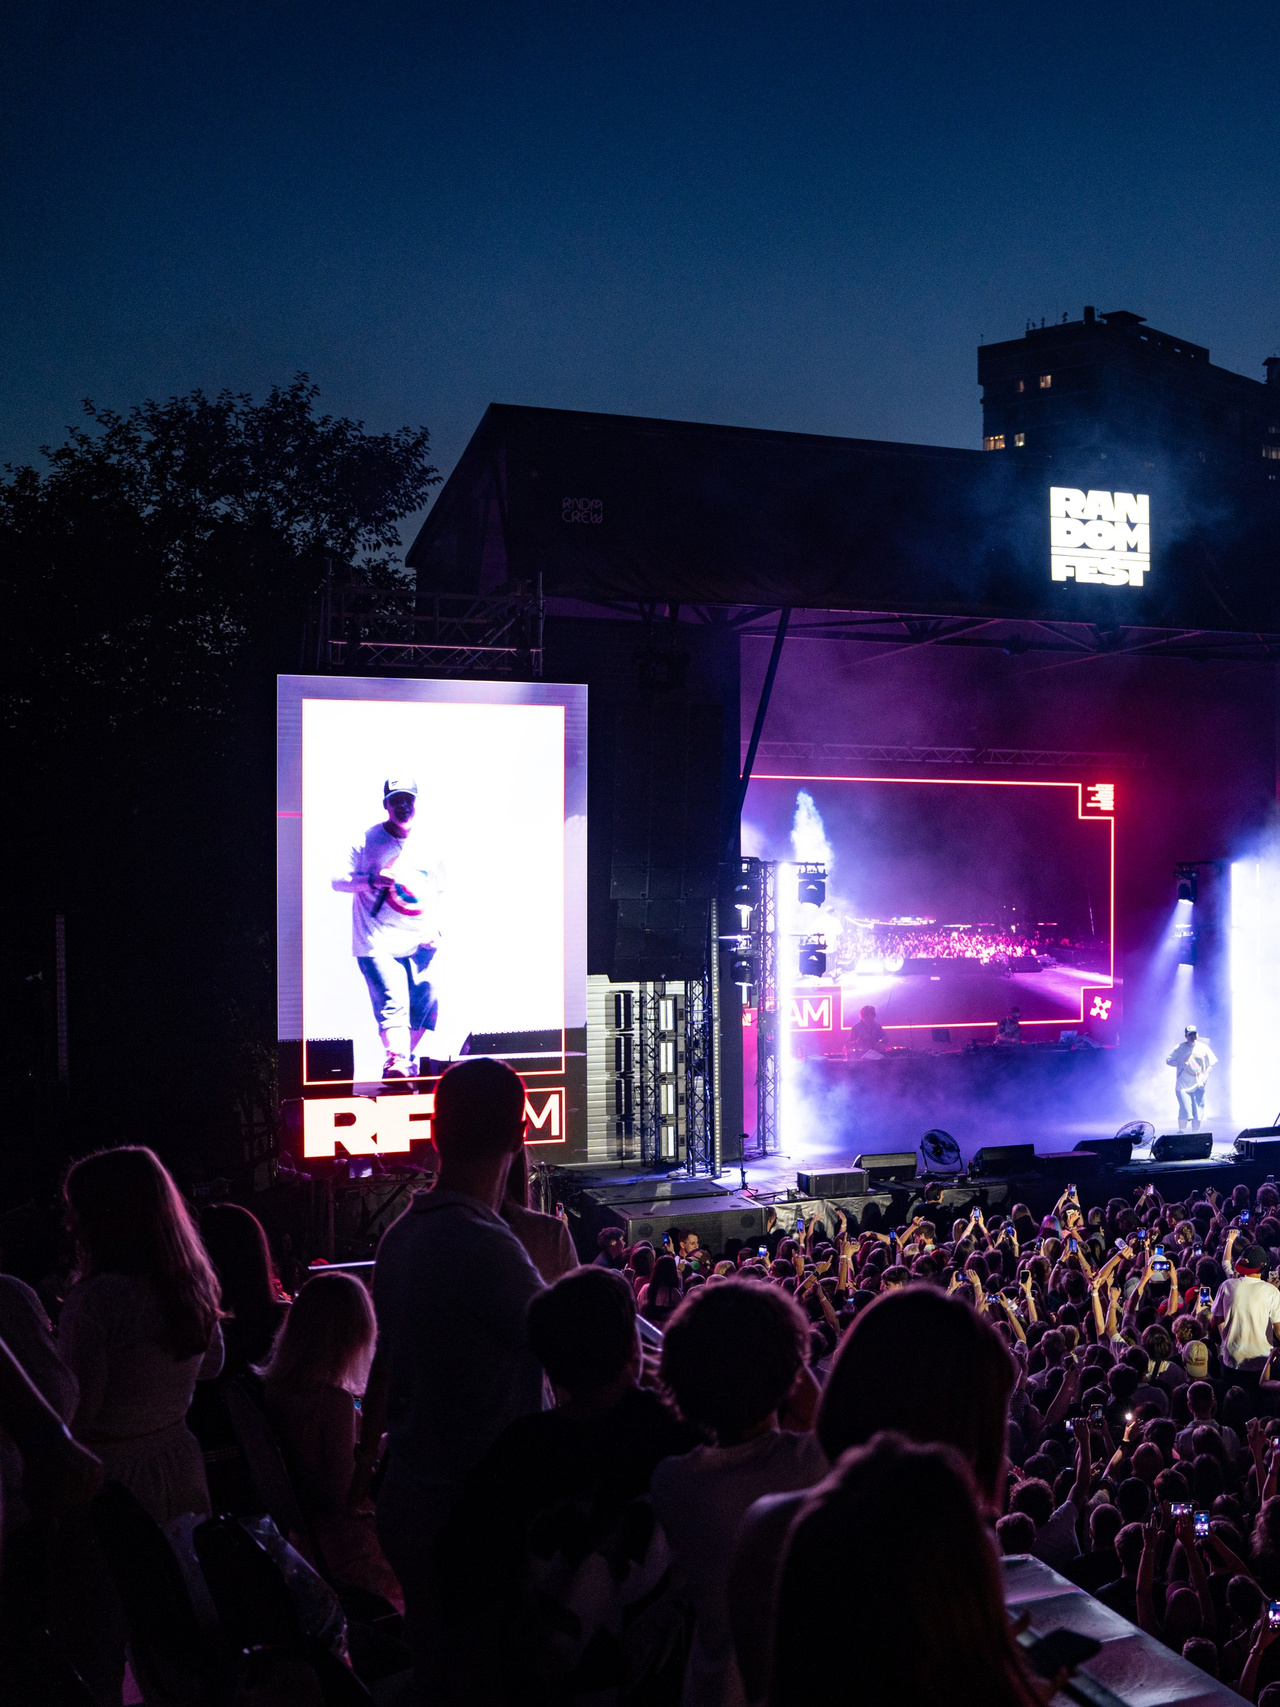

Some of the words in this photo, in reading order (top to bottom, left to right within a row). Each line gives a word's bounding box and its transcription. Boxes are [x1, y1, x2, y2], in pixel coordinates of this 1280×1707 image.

[562, 510, 603, 523] CREW
[1050, 487, 1150, 524] RAN
[1050, 516, 1150, 553] DOM
[1051, 555, 1150, 587] FEST
[786, 998, 829, 1028] AM
